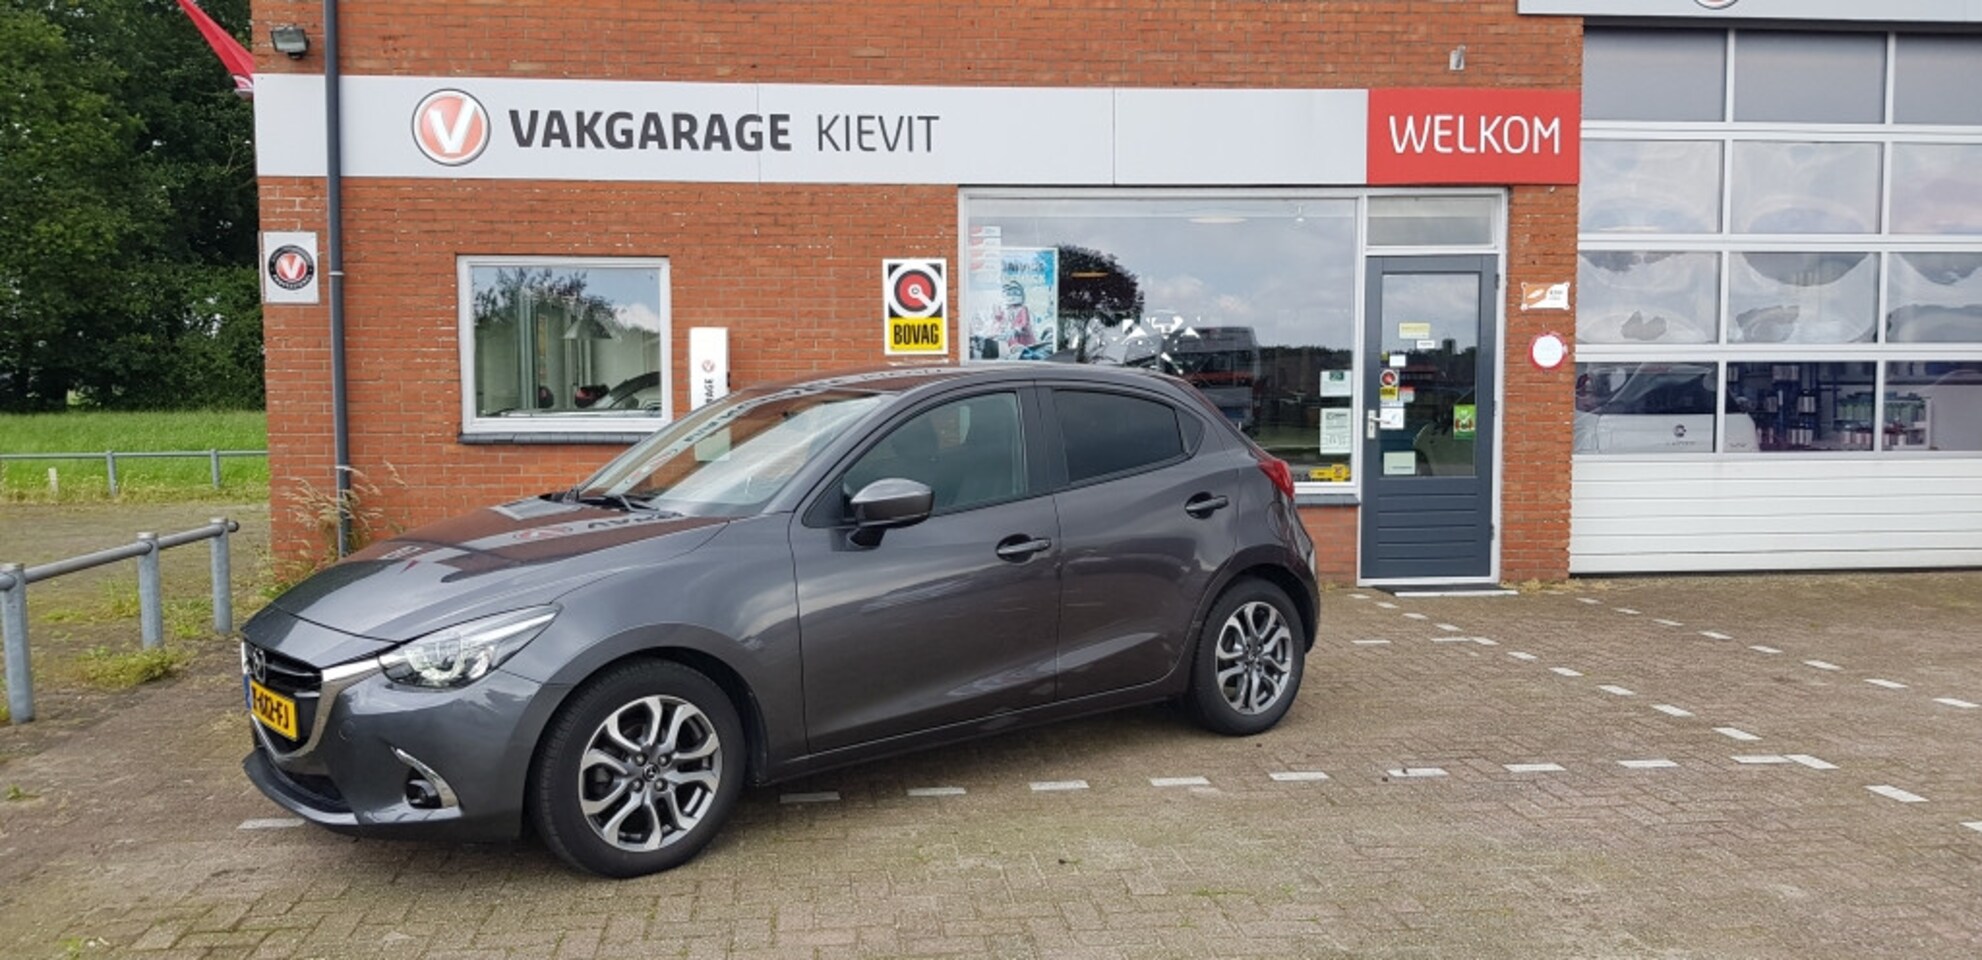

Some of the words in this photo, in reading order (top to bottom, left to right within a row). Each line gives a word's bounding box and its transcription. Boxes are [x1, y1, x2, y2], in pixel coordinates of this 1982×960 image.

[508, 109, 792, 152] VAKGARAGE
[817, 114, 940, 152] KIEVIT
[1389, 114, 1560, 154] WELKOM
[893, 323, 939, 345] BOVAG
